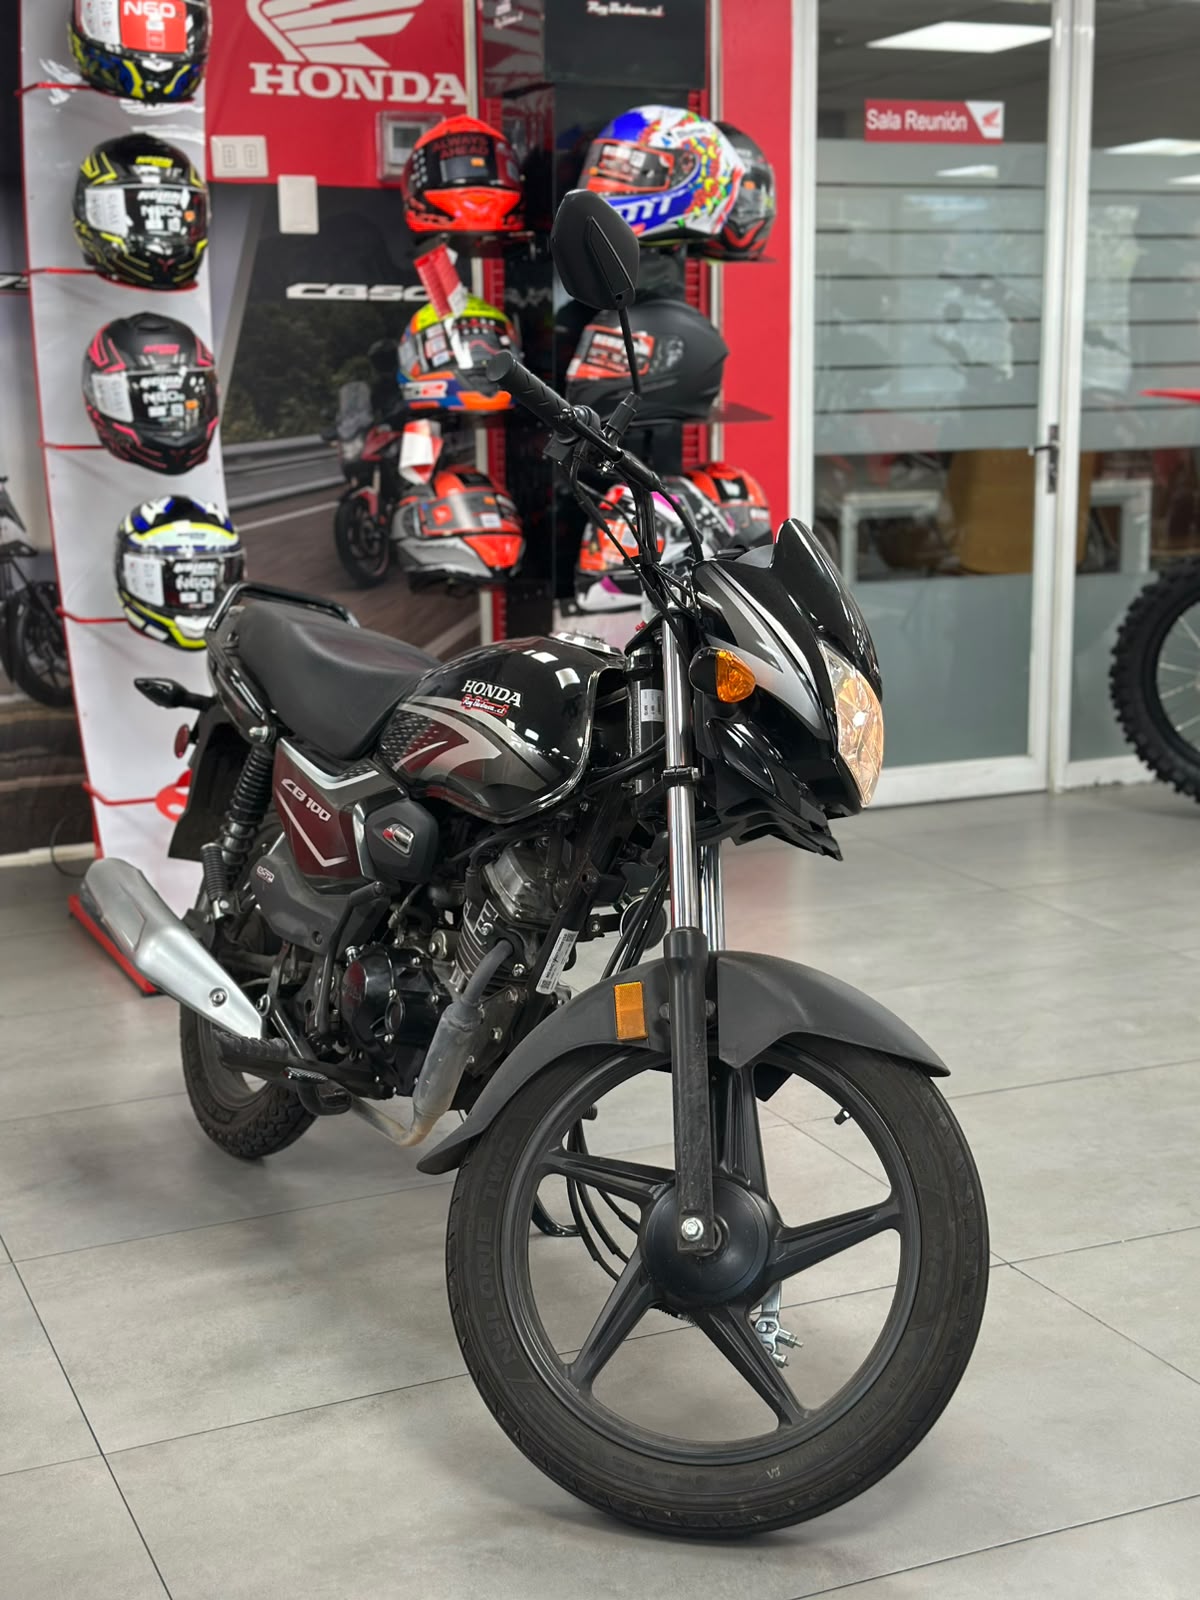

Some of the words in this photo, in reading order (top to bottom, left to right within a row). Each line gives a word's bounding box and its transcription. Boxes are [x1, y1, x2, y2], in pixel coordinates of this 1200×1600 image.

[249, 62, 467, 106] HONDA
[866, 108, 901, 130] Sala
[904, 109, 968, 132] Reunión
[461, 680, 521, 708] HONDA
[281, 778, 307, 802] CB
[306, 797, 331, 822] 100
